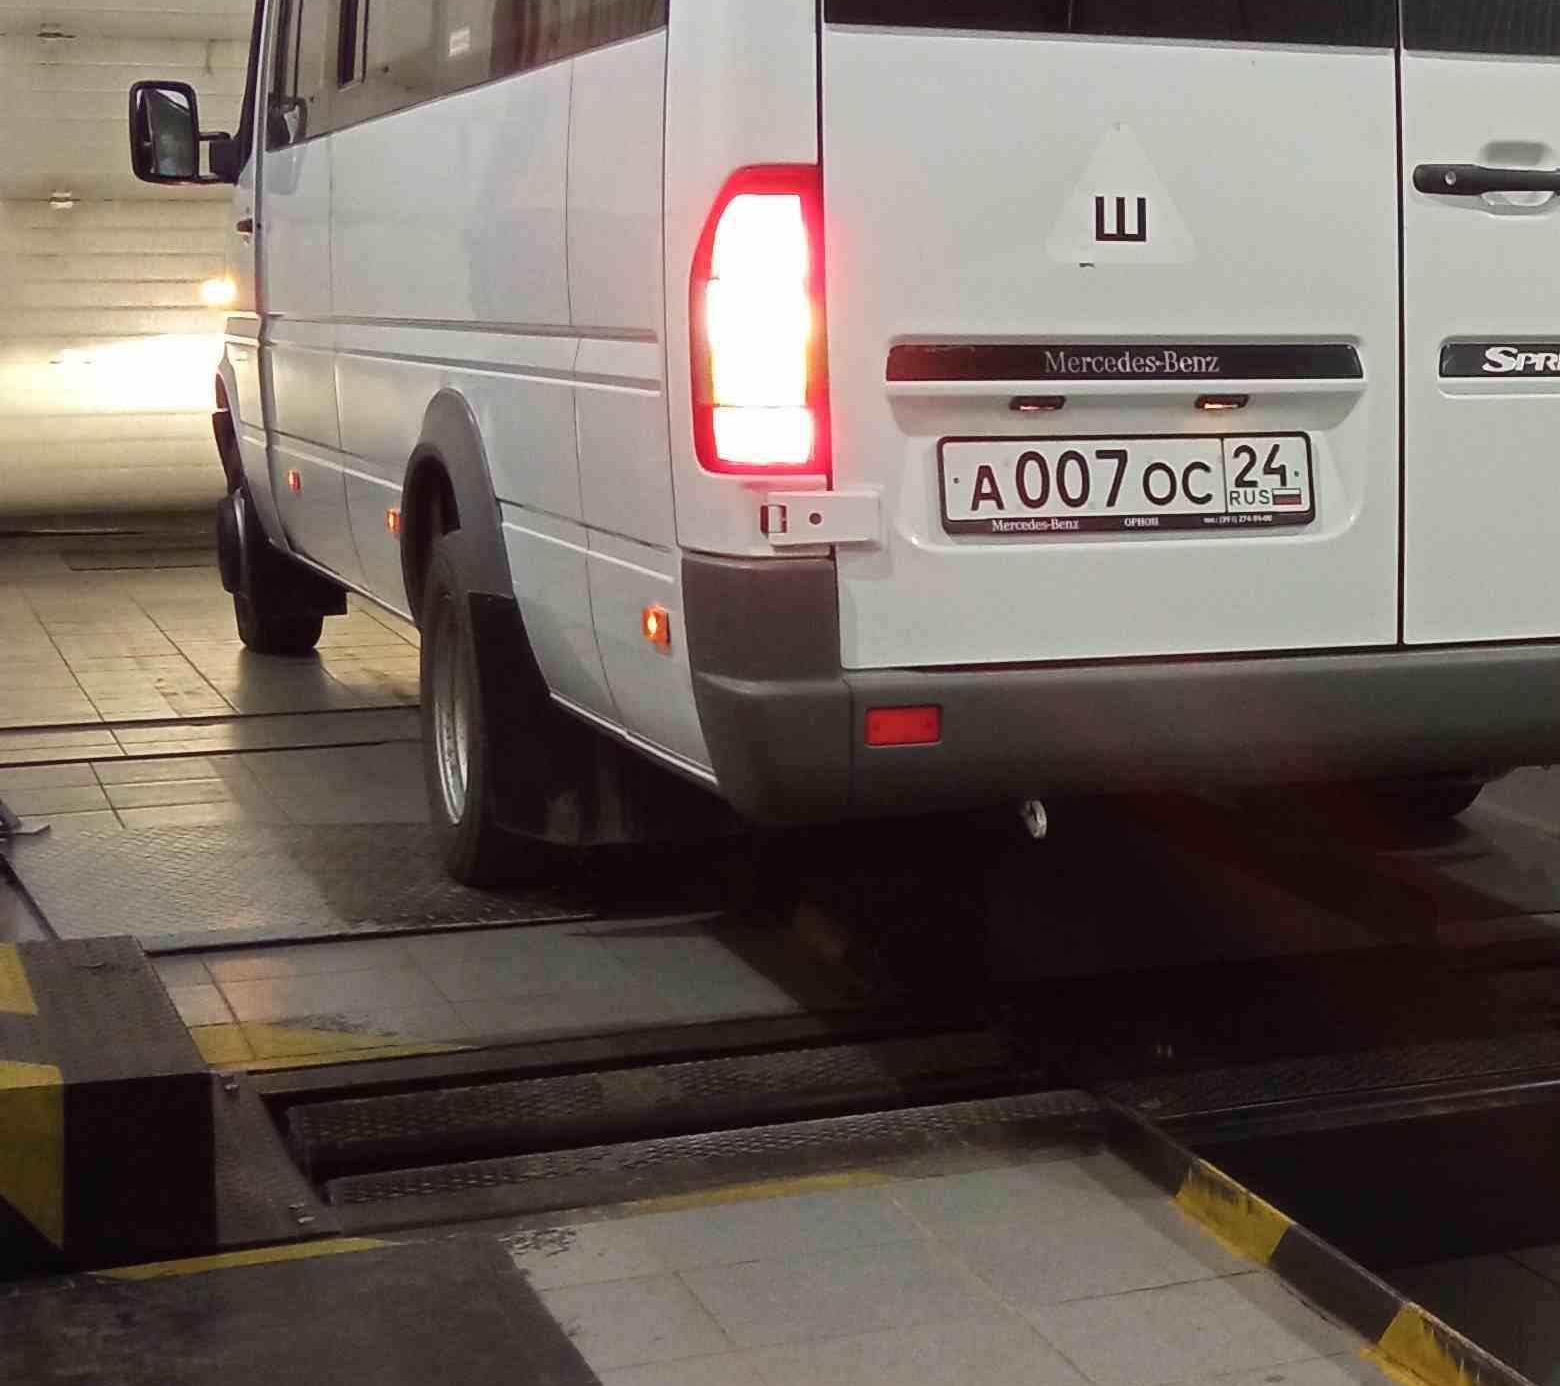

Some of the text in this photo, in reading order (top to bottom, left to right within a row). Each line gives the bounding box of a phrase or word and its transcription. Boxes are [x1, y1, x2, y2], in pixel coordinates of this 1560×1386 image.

[1045, 351, 1220, 375] Mercedes-Benz
[1232, 443, 1288, 489] 24
[1229, 490, 1271, 507] RUS
[991, 518, 1080, 533] Mercedes-Benz
